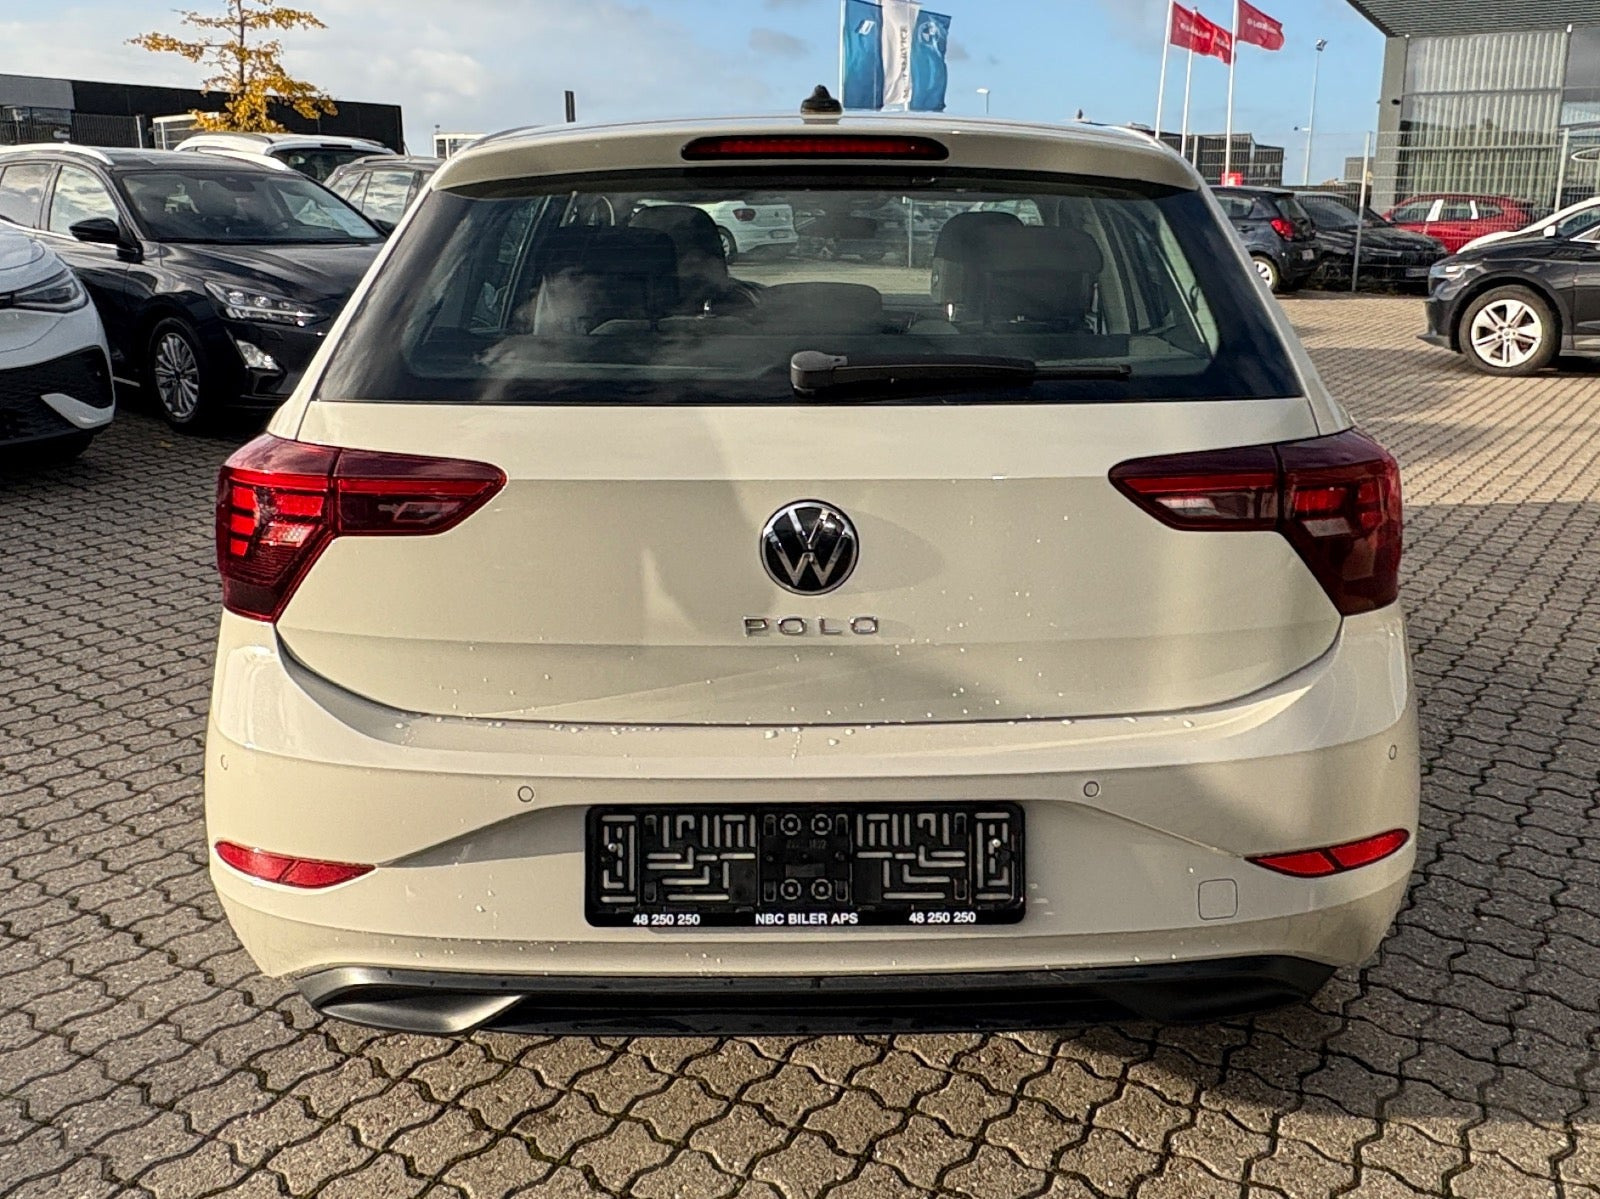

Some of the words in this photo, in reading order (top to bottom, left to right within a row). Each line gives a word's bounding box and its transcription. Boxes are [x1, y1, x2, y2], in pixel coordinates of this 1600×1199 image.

[742, 615, 879, 637] POLO
[632, 913, 649, 926] 48
[651, 913, 675, 926] 250
[677, 913, 701, 926] 250
[755, 913, 785, 925] NBC
[788, 913, 828, 925] BILER
[830, 912, 859, 925] APS
[908, 911, 925, 924] 48
[927, 911, 951, 924] 250
[953, 911, 977, 924] 250
